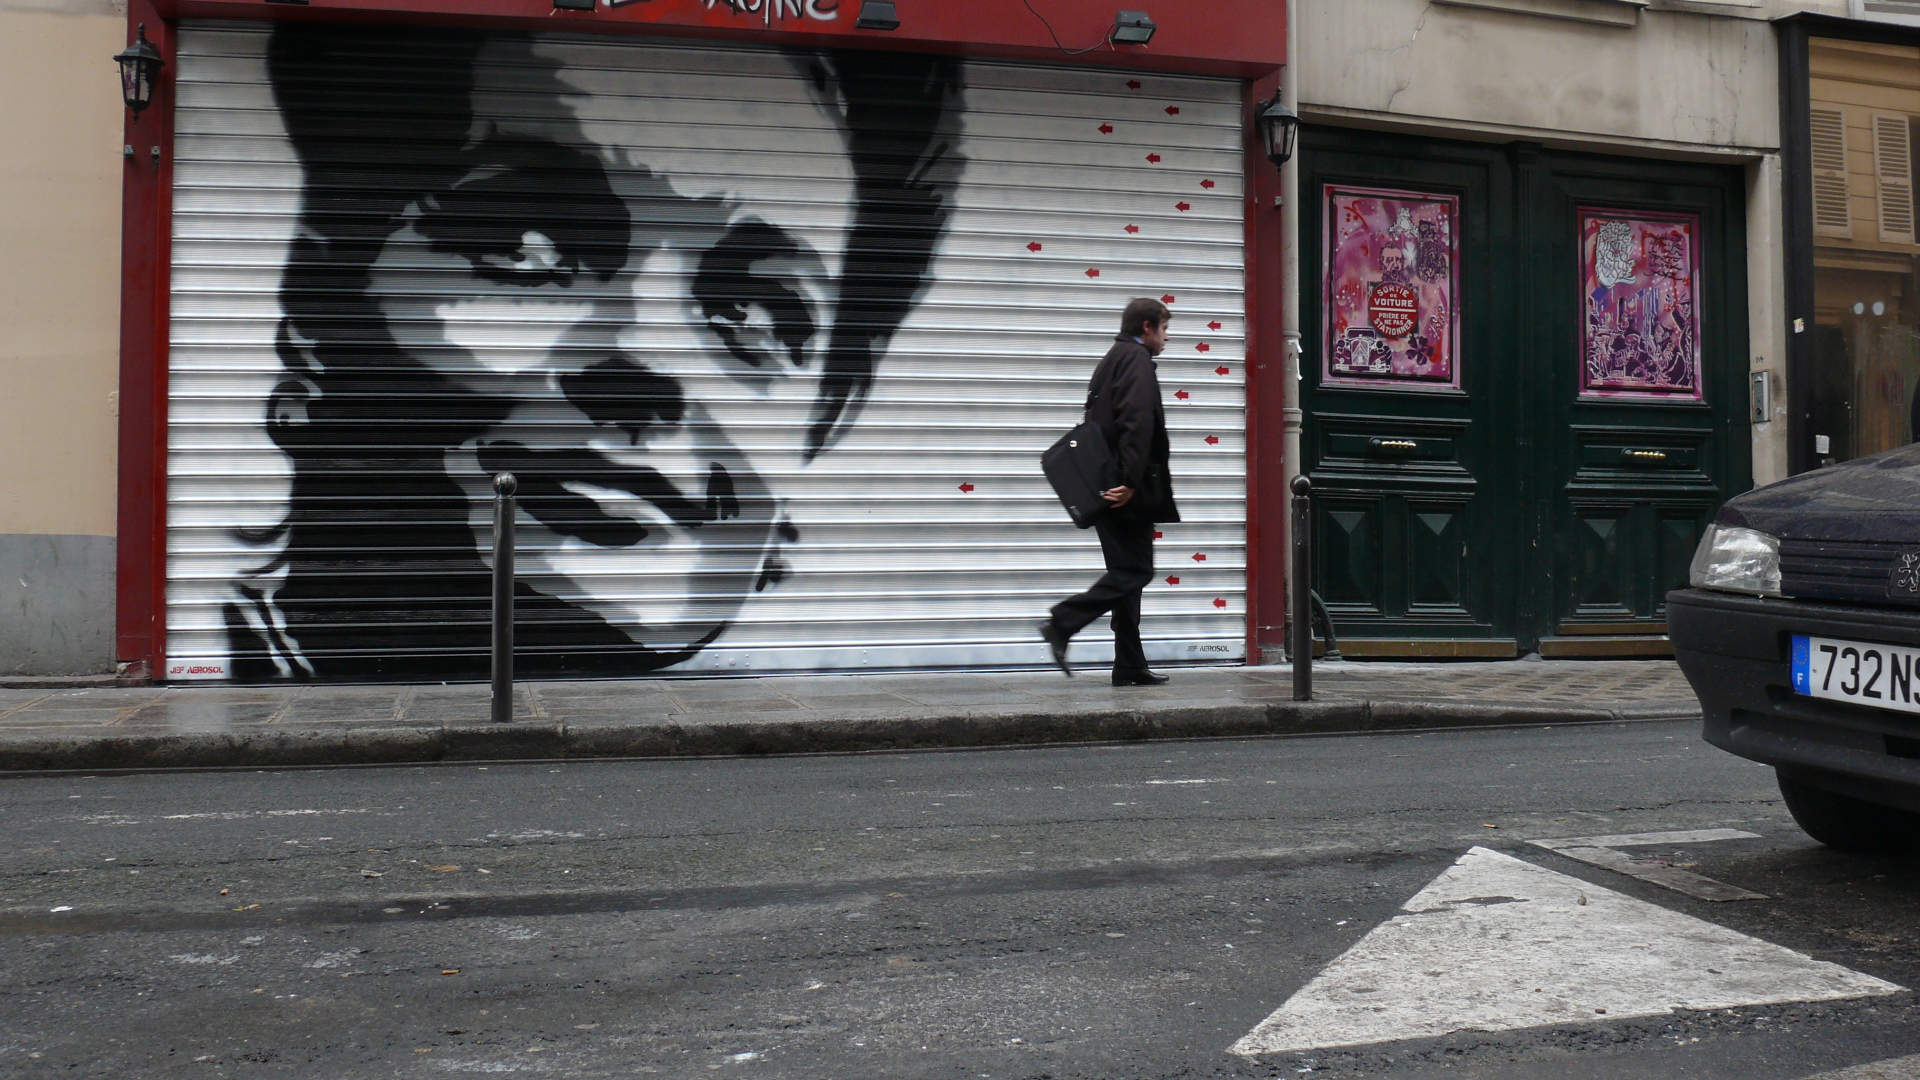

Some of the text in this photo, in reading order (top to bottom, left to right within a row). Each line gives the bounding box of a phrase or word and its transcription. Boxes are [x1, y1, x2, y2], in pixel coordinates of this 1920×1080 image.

[1377, 285, 1409, 298] SORTIE
[1374, 298, 1413, 307] VOITURE
[1374, 318, 1413, 335] STATIONNER
[170, 666, 224, 674] JEF AEROSOL
[1820, 644, 1883, 699] 732
[1797, 672, 1804, 685] F
